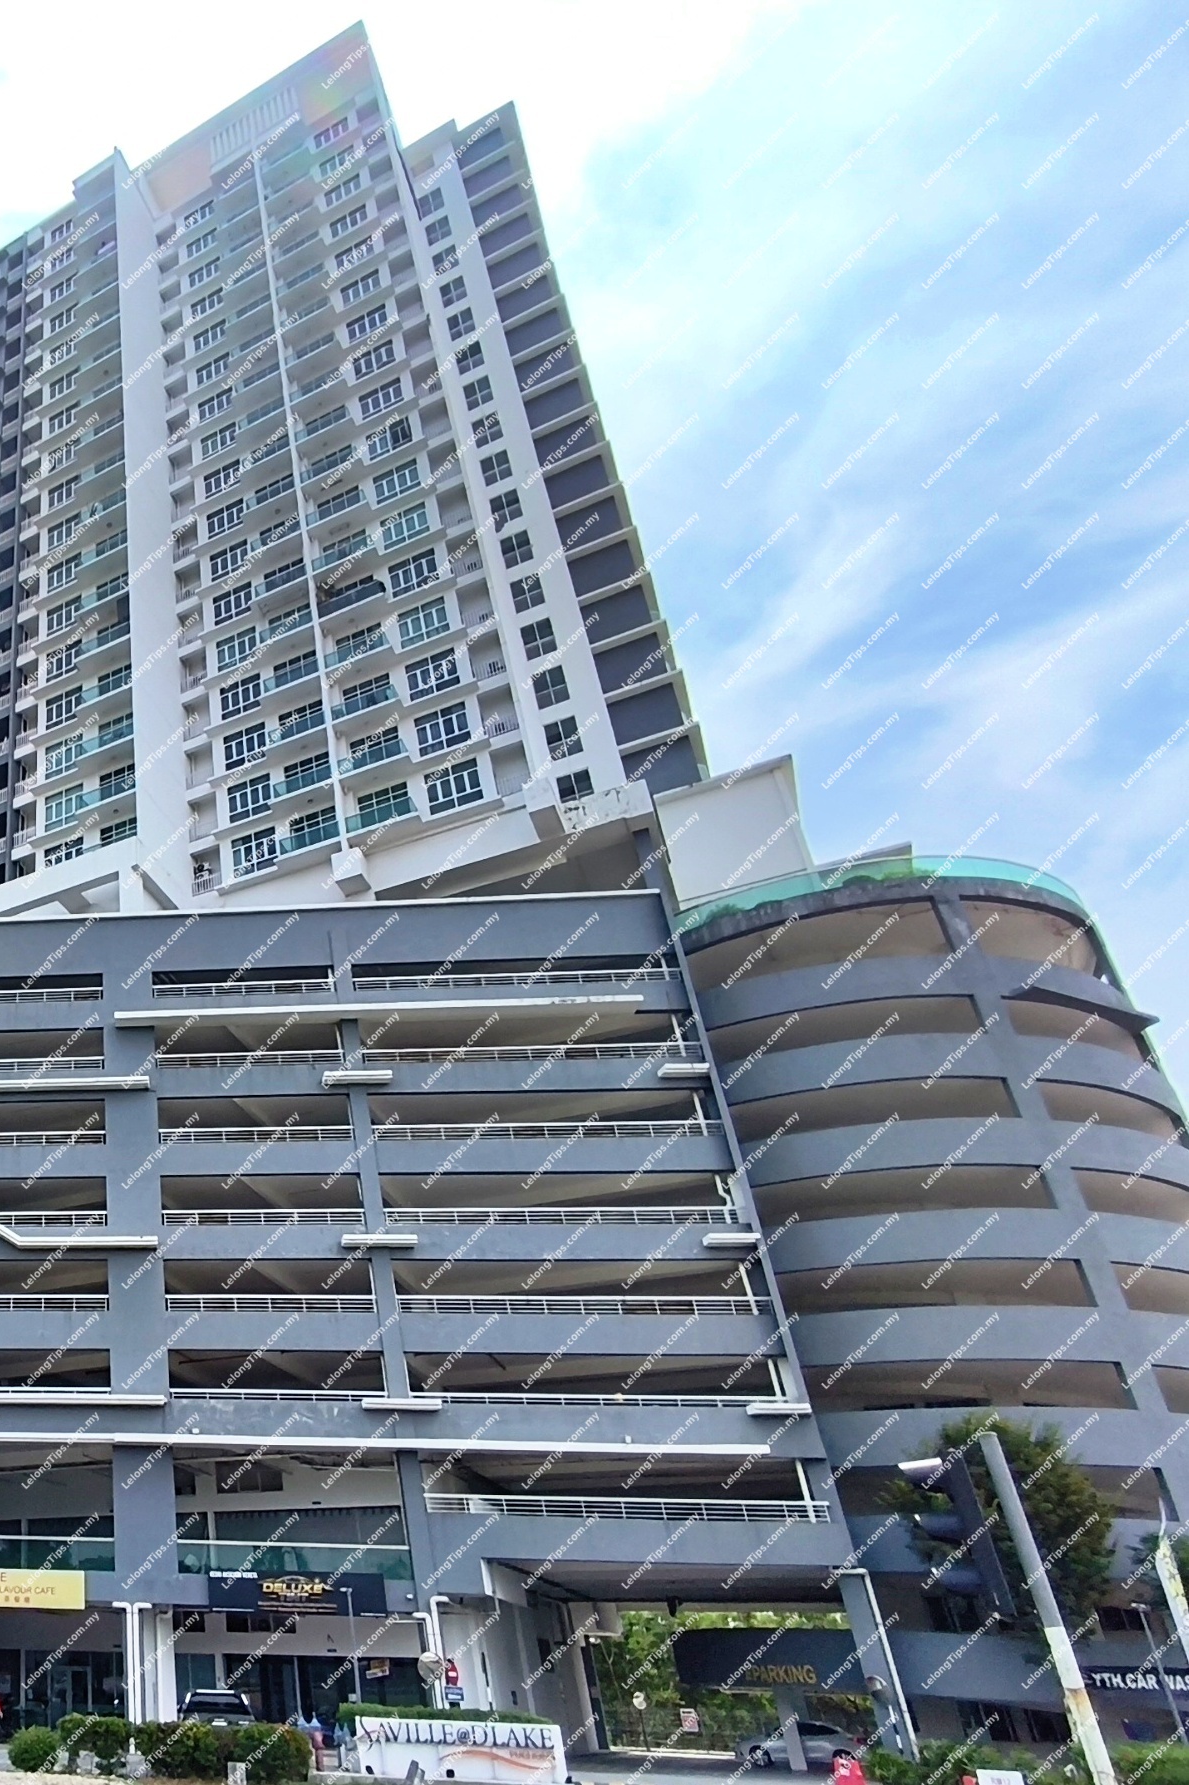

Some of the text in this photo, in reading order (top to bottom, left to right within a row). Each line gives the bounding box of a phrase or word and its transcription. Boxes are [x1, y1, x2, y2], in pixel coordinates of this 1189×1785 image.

[34, 1586, 56, 1595] CAFE
[262, 1582, 323, 1594] DELUXE
[1125, 1673, 1160, 1690] CAR
